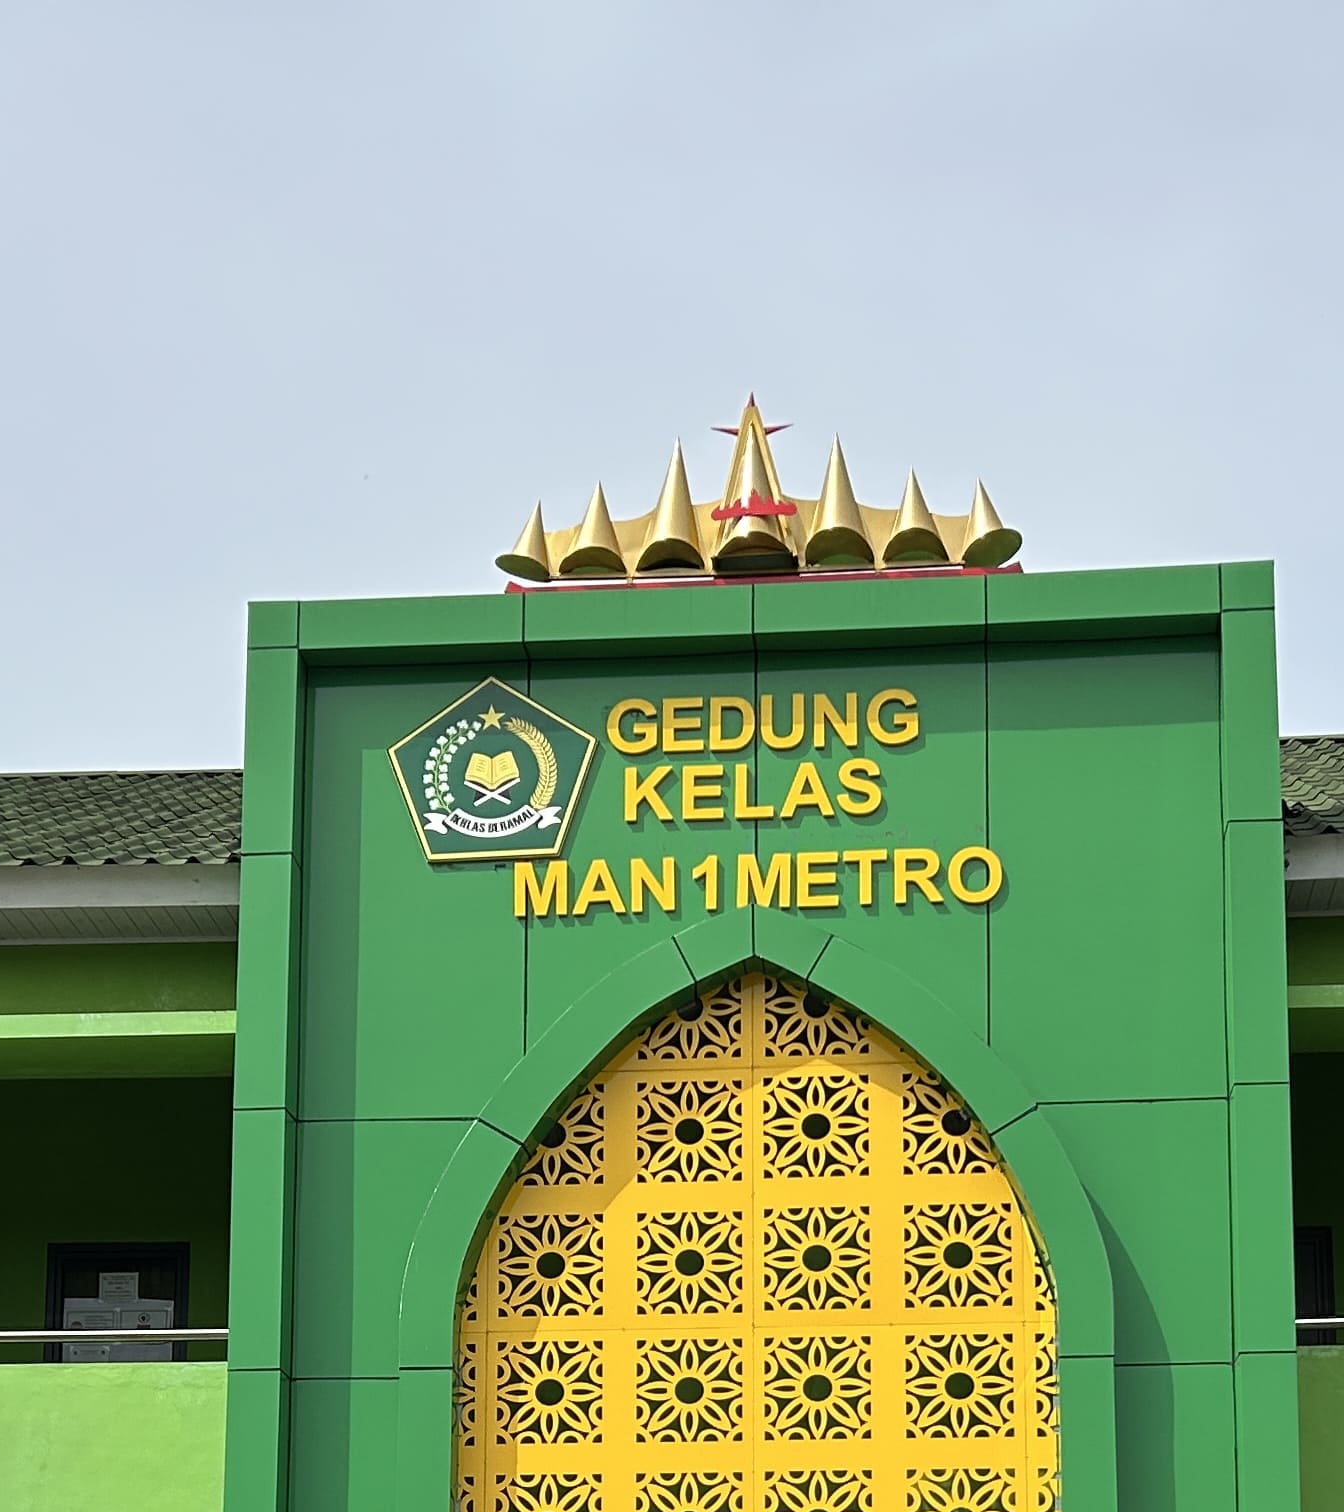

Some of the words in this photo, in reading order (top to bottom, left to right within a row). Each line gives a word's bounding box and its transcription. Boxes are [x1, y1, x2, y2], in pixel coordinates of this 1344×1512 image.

[606, 689, 920, 755] GEDUNG
[624, 757, 883, 822] KELAS
[449, 813, 486, 833] IKHLAS
[513, 858, 676, 917] MAN
[692, 855, 718, 911] 1
[736, 845, 1003, 909] METRO
